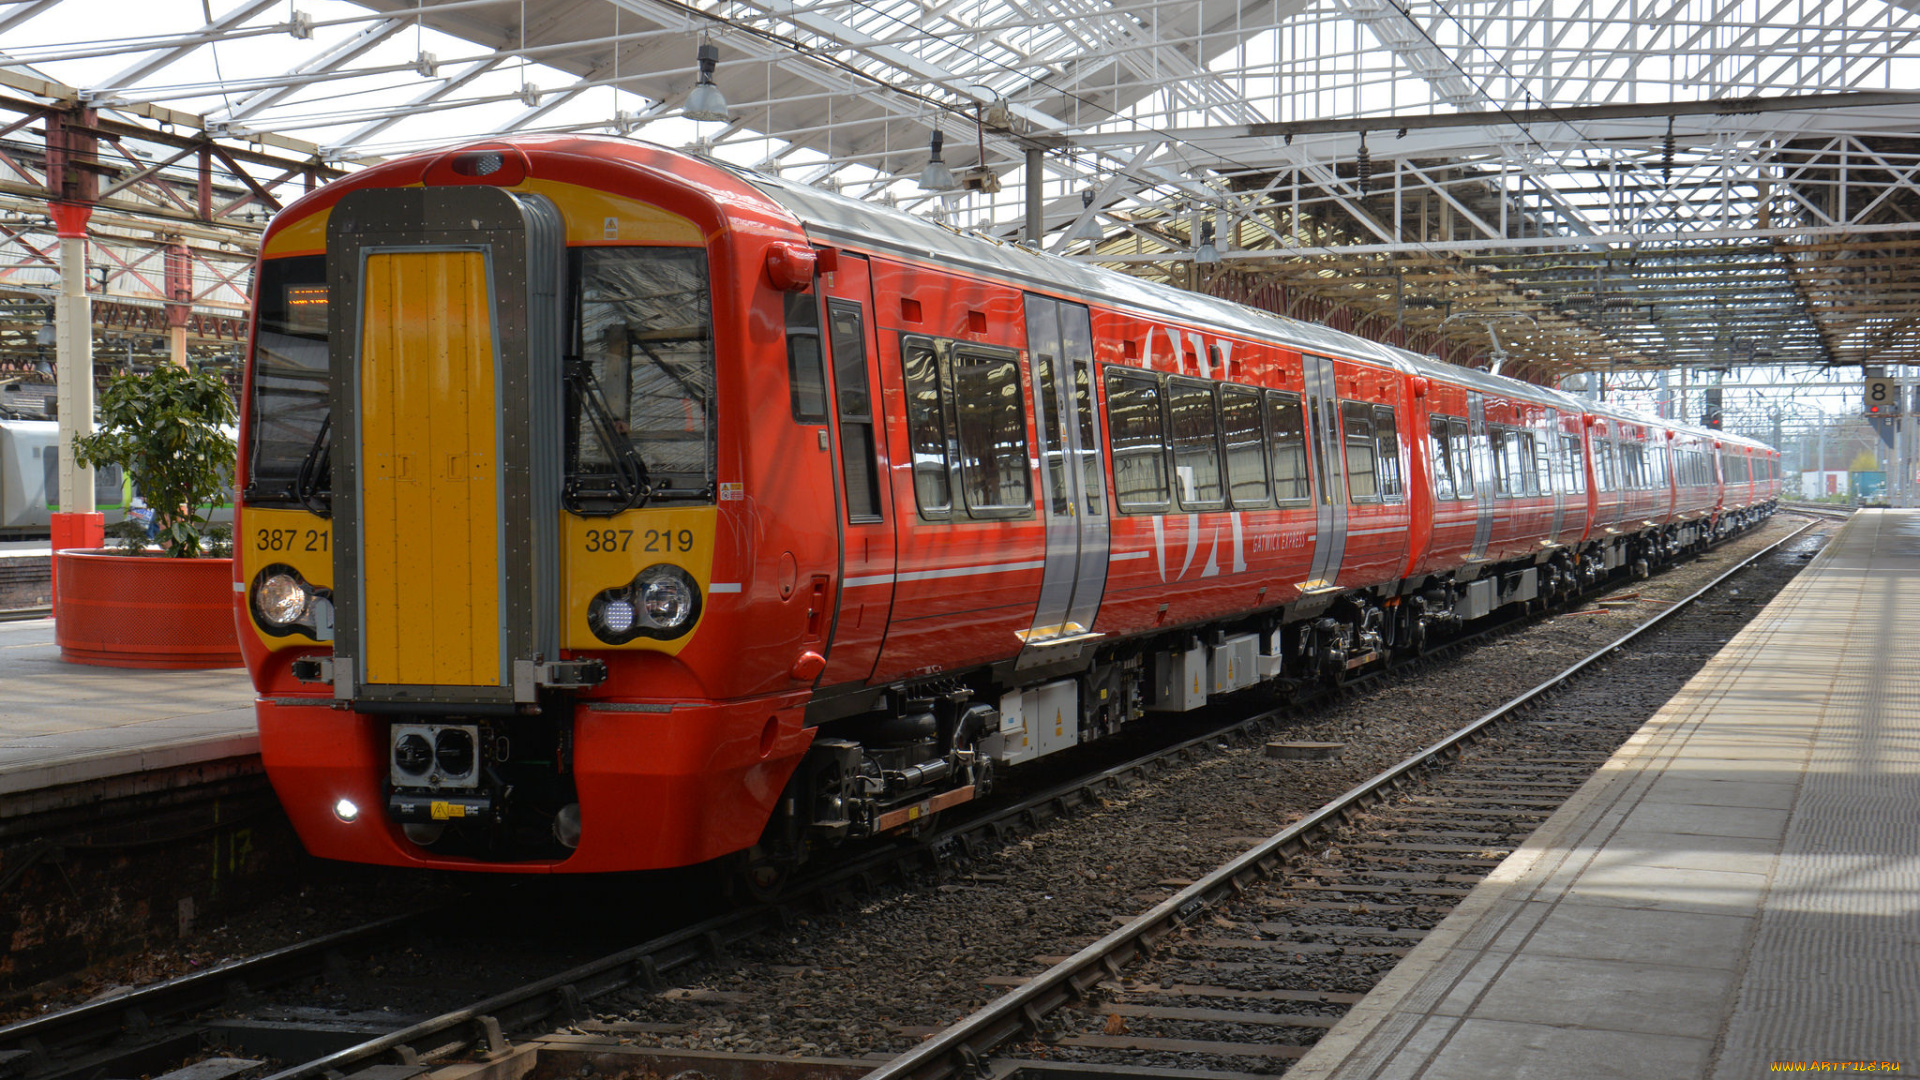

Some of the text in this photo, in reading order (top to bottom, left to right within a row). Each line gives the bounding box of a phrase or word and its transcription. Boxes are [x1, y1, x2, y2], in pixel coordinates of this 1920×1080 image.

[1871, 382, 1886, 401] 8
[257, 529, 328, 552] 387 21
[585, 529, 693, 552] 387 219
[1253, 530, 1306, 553] GATWICK EXPRESS
